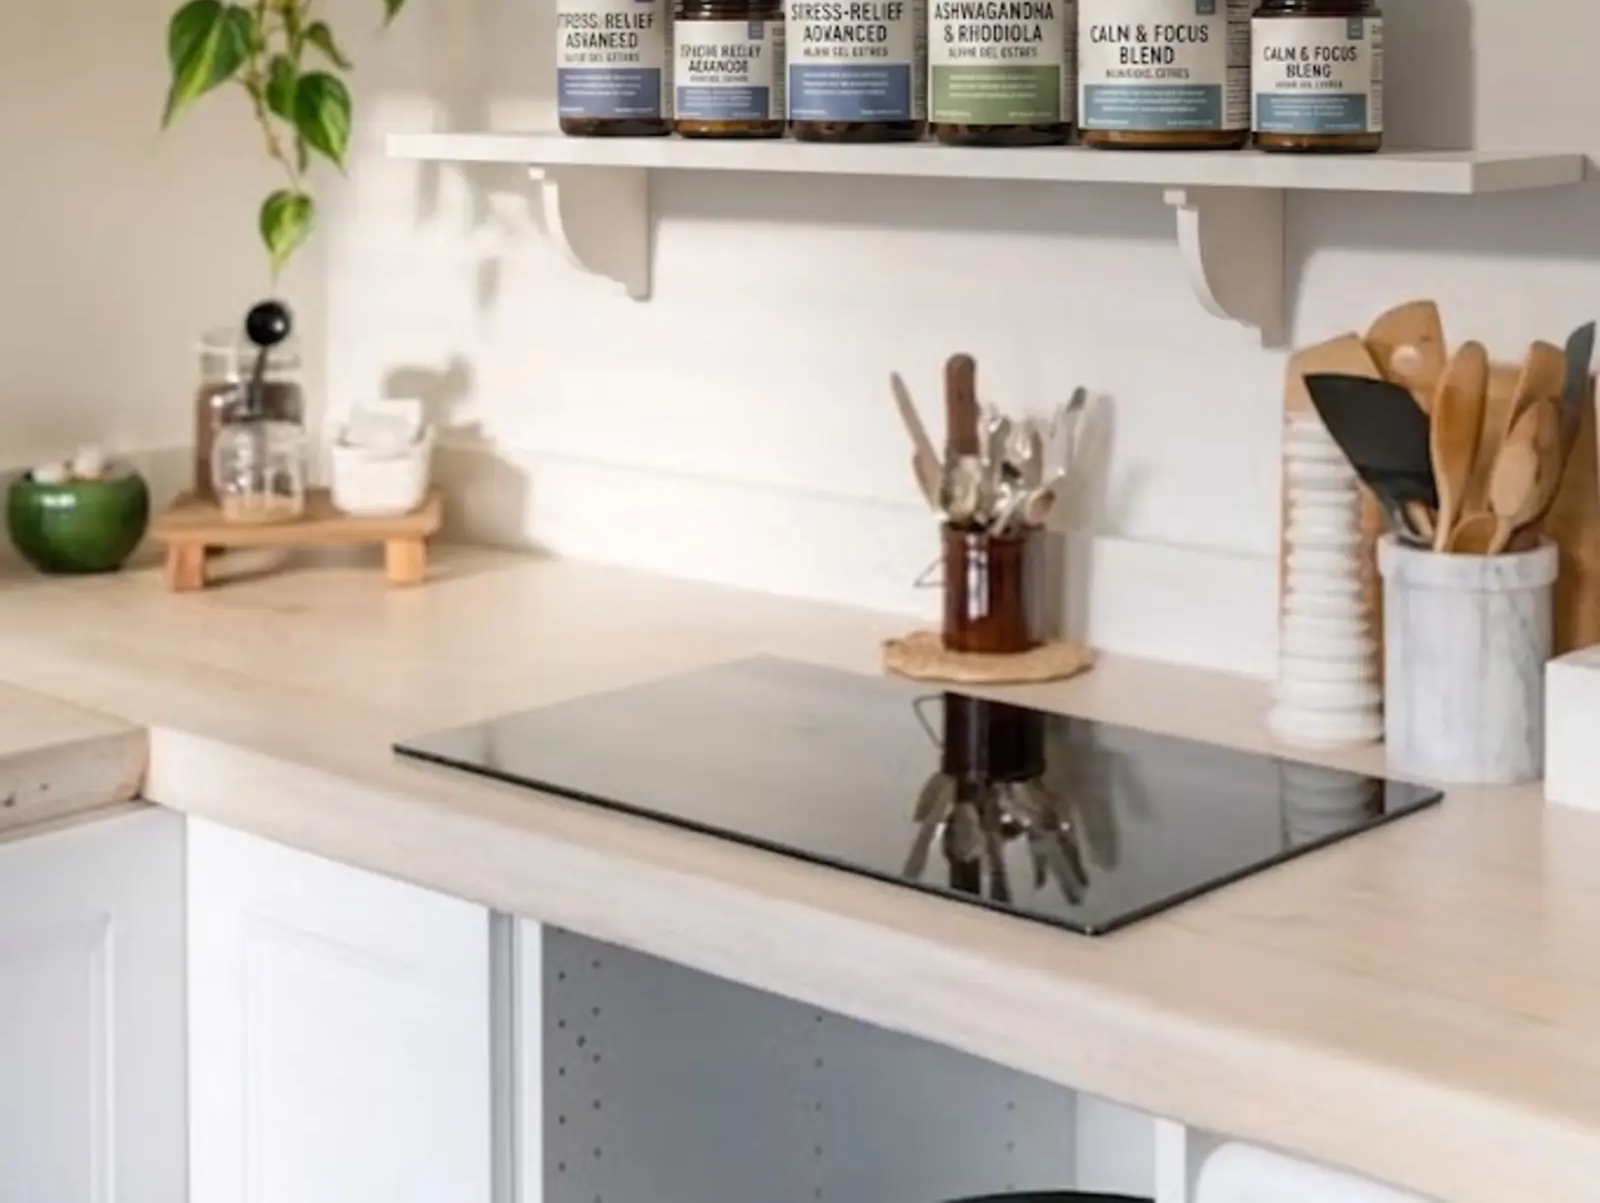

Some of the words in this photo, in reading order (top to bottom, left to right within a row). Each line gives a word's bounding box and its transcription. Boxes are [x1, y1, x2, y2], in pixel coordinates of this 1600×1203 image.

[790, 1, 904, 21] STRESS-RELIEF
[934, 1, 1054, 20] ASHWAGANDHA
[1135, 24, 1148, 44] &
[1154, 24, 1209, 44] FOCUS
[1119, 45, 1175, 65] BLEND
[1314, 45, 1358, 62] FOCUS
